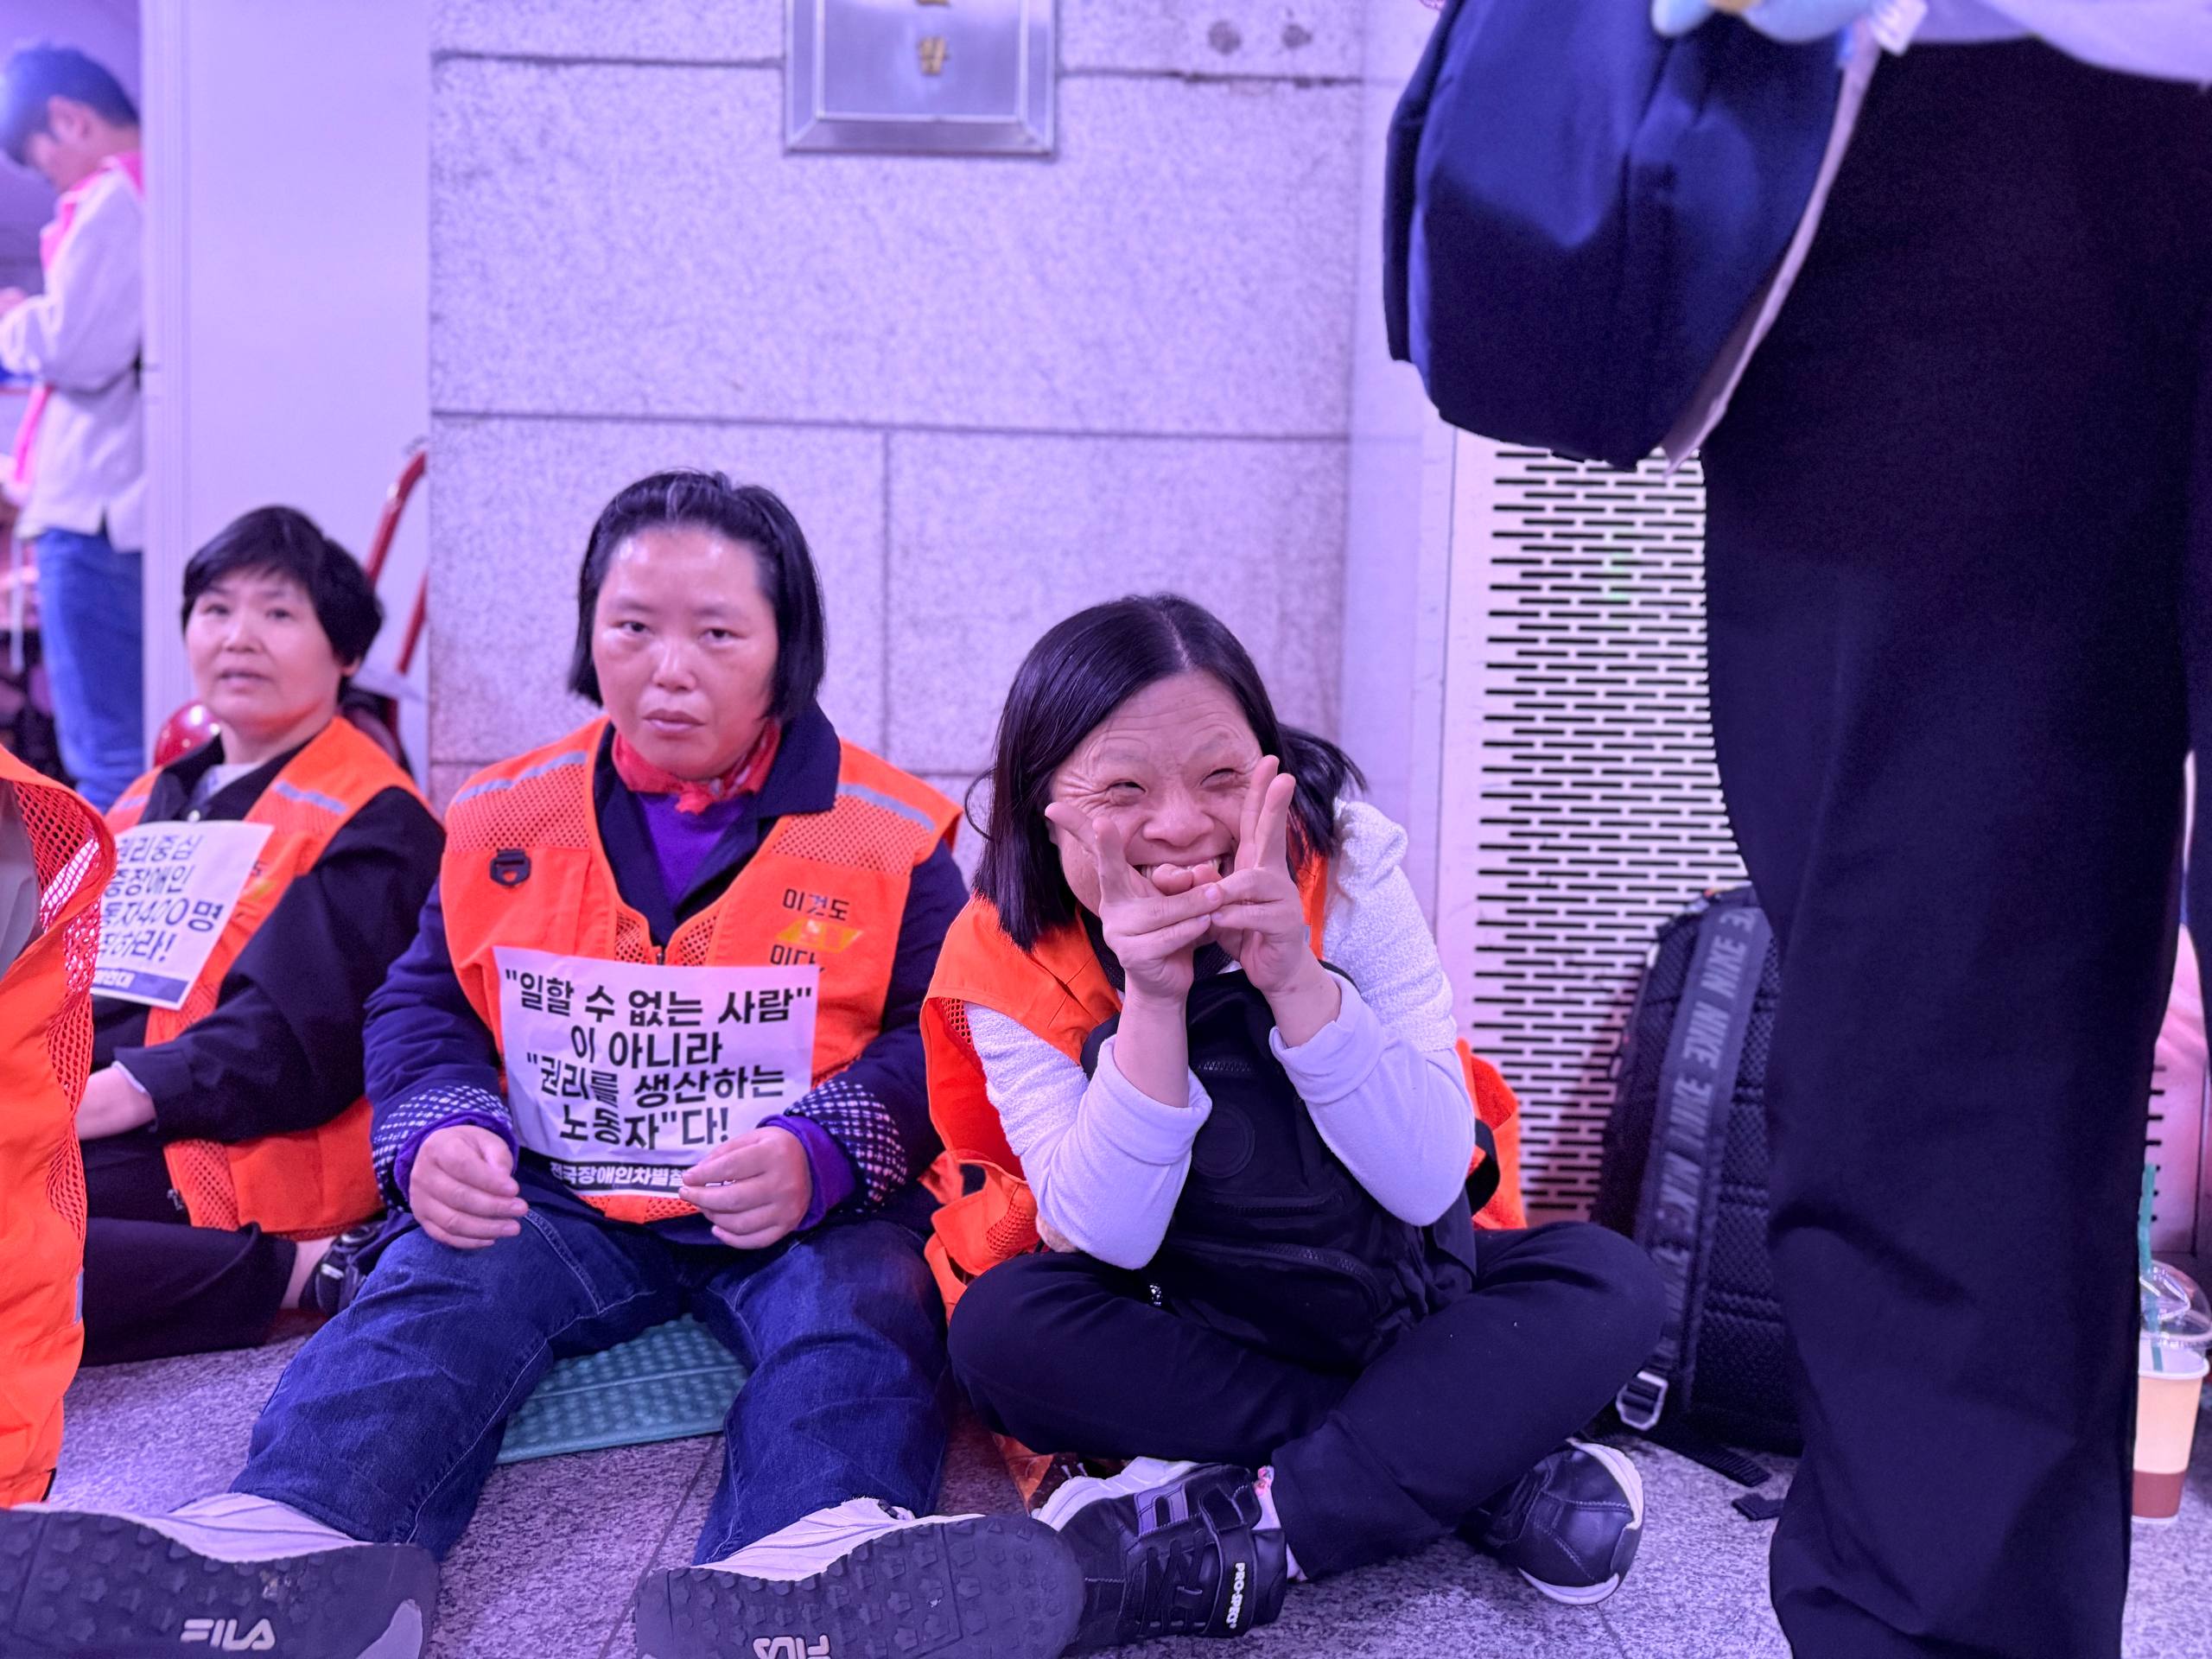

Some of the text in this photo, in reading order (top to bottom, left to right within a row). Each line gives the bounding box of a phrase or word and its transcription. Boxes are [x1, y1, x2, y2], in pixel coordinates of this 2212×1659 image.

[105, 865, 195, 898] 증장애인
[101, 898, 224, 931] 동자400명
[783, 889, 849, 921] 이것도
[1701, 935, 1746, 998] NIKE
[505, 969, 812, 1027] "일할 수 없는 사람"
[571, 1026, 723, 1070] 이 아니라
[1682, 1001, 1729, 1070] NIKE
[527, 1052, 785, 1108] "권리를 생산하는
[560, 1105, 729, 1149] 노동자"다!
[550, 1161, 736, 1188] 전국장애인차별철
[180, 1618, 276, 1651] FILA
